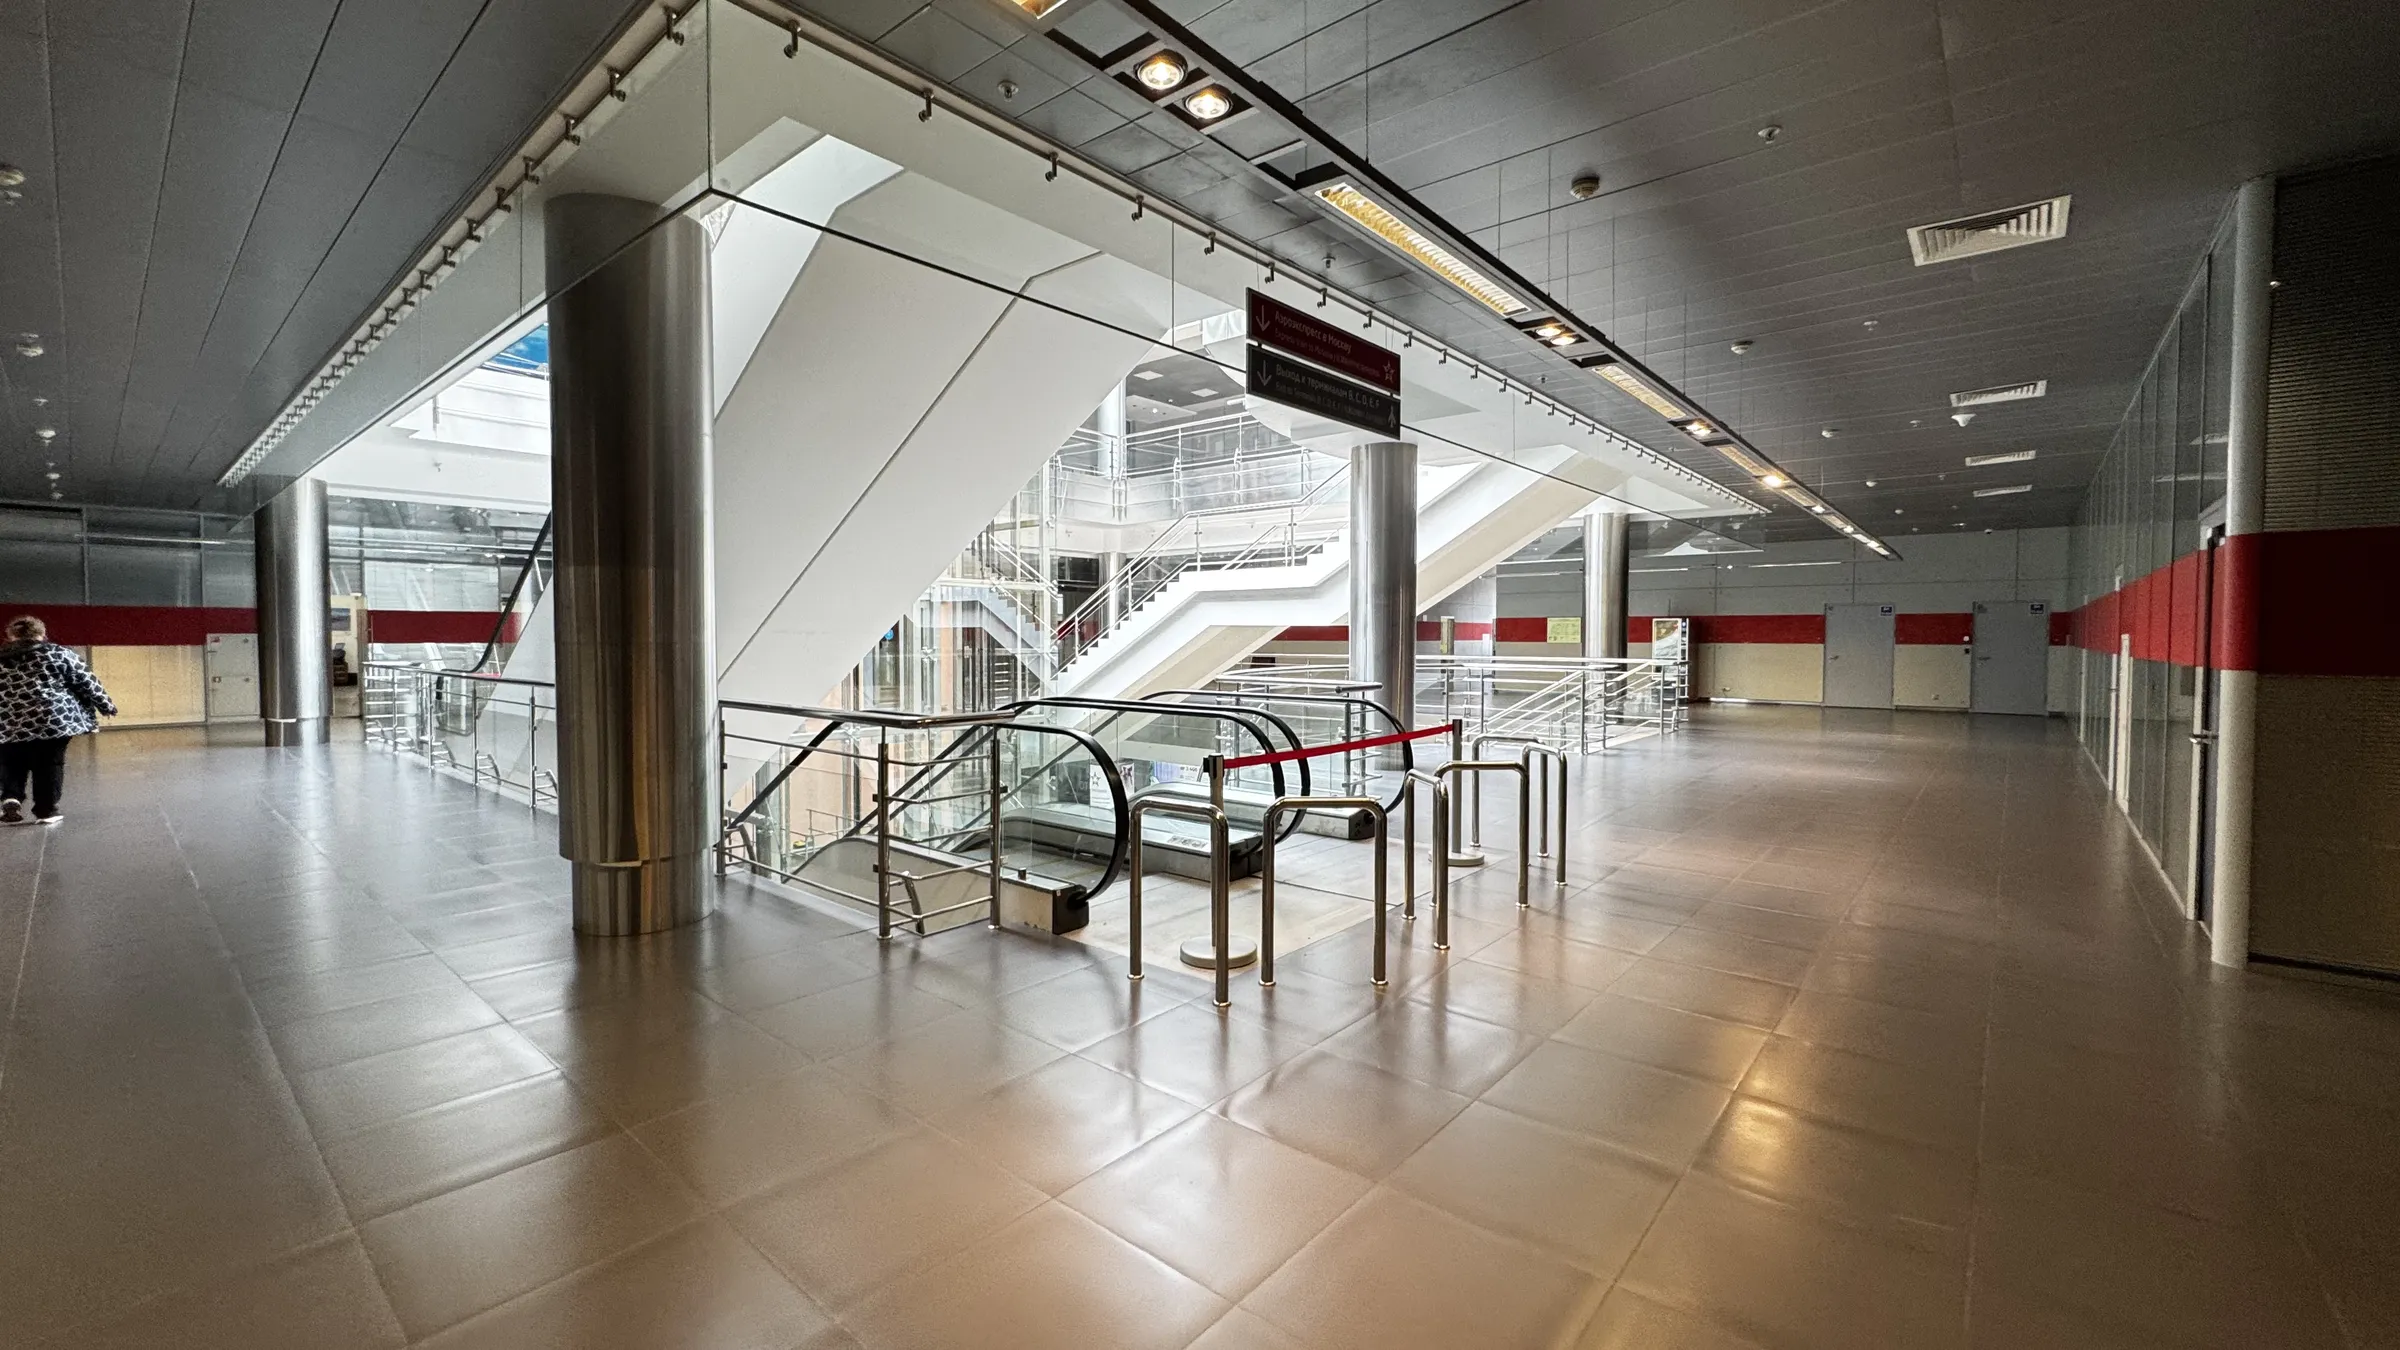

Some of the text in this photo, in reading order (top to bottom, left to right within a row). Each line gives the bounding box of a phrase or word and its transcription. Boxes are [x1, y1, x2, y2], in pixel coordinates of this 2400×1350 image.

[1275, 311, 1352, 354] Аэроэкспресс в Москву
[1276, 364, 1301, 383] Выход
[1301, 375, 1306, 384] к
[1307, 377, 1347, 399] терминалам
[1375, 399, 1380, 409] F
